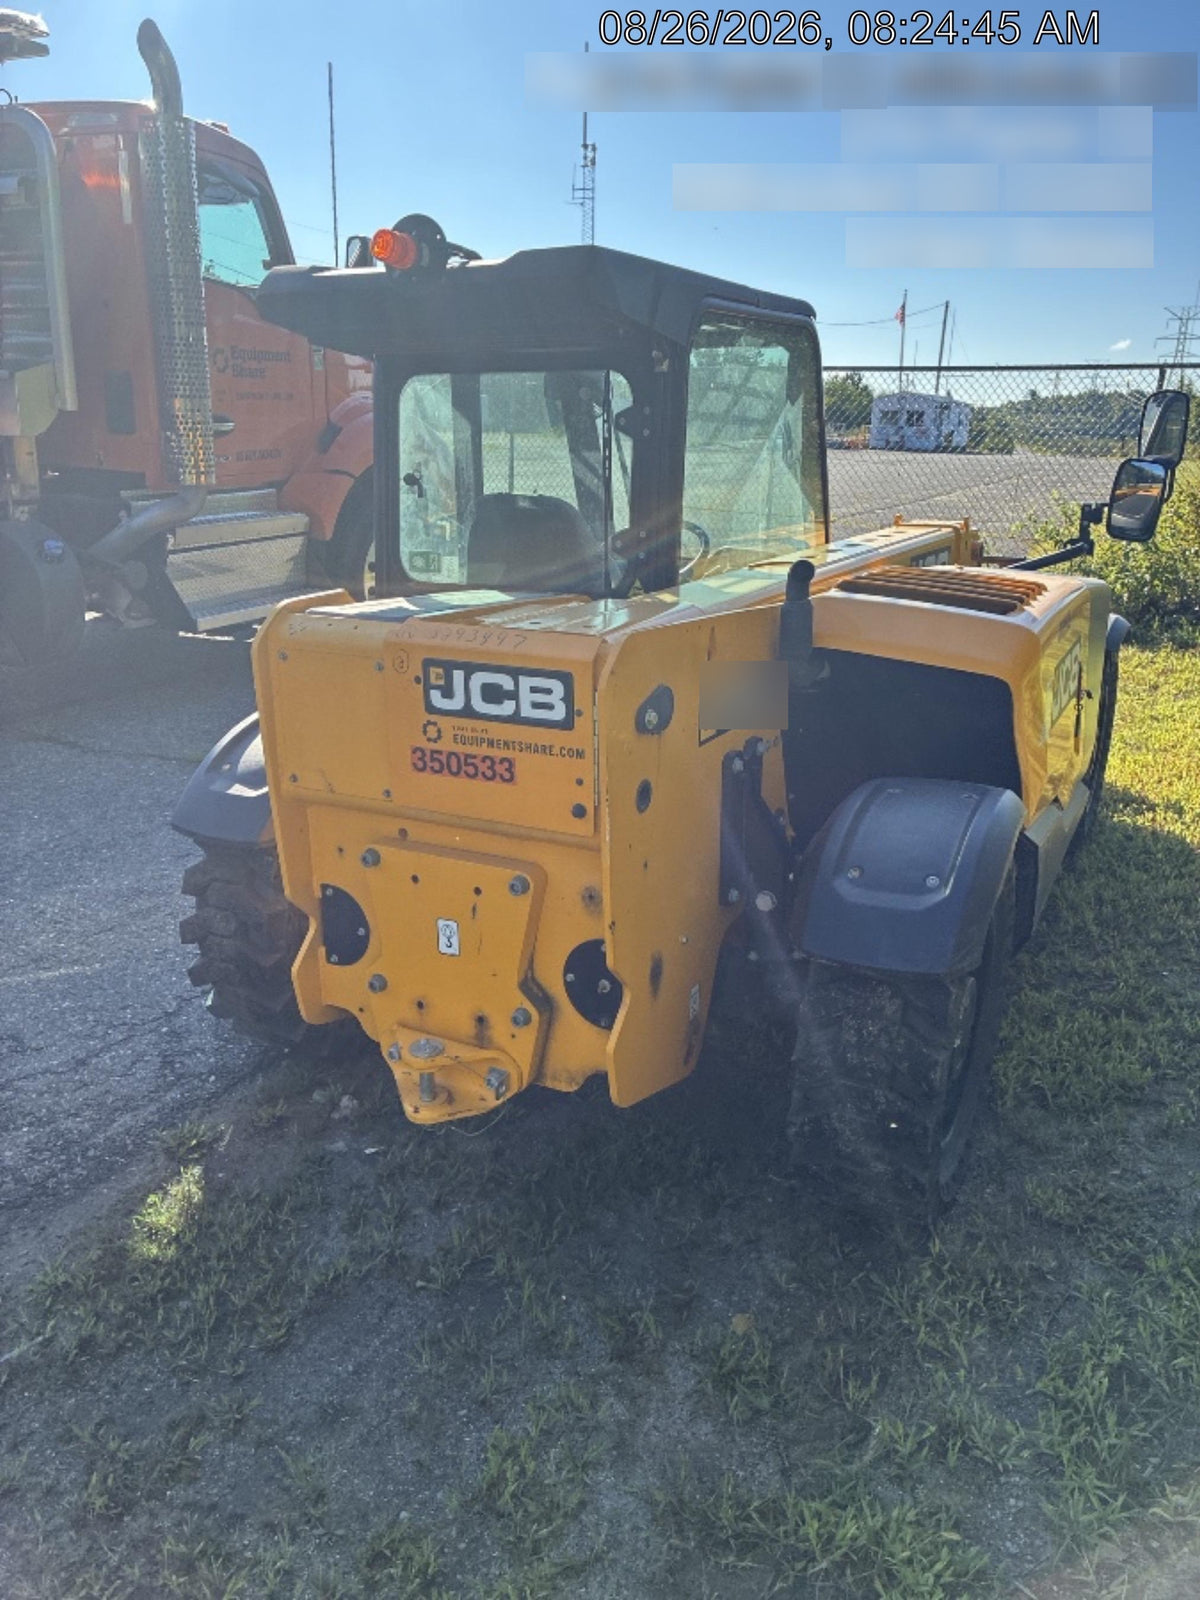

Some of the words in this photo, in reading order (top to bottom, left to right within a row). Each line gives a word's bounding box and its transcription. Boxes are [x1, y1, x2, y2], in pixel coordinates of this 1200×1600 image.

[430, 669, 567, 720] JCB
[411, 746, 516, 784] 350533
[452, 733, 586, 760] EQUIPMENTSHARE.COM
